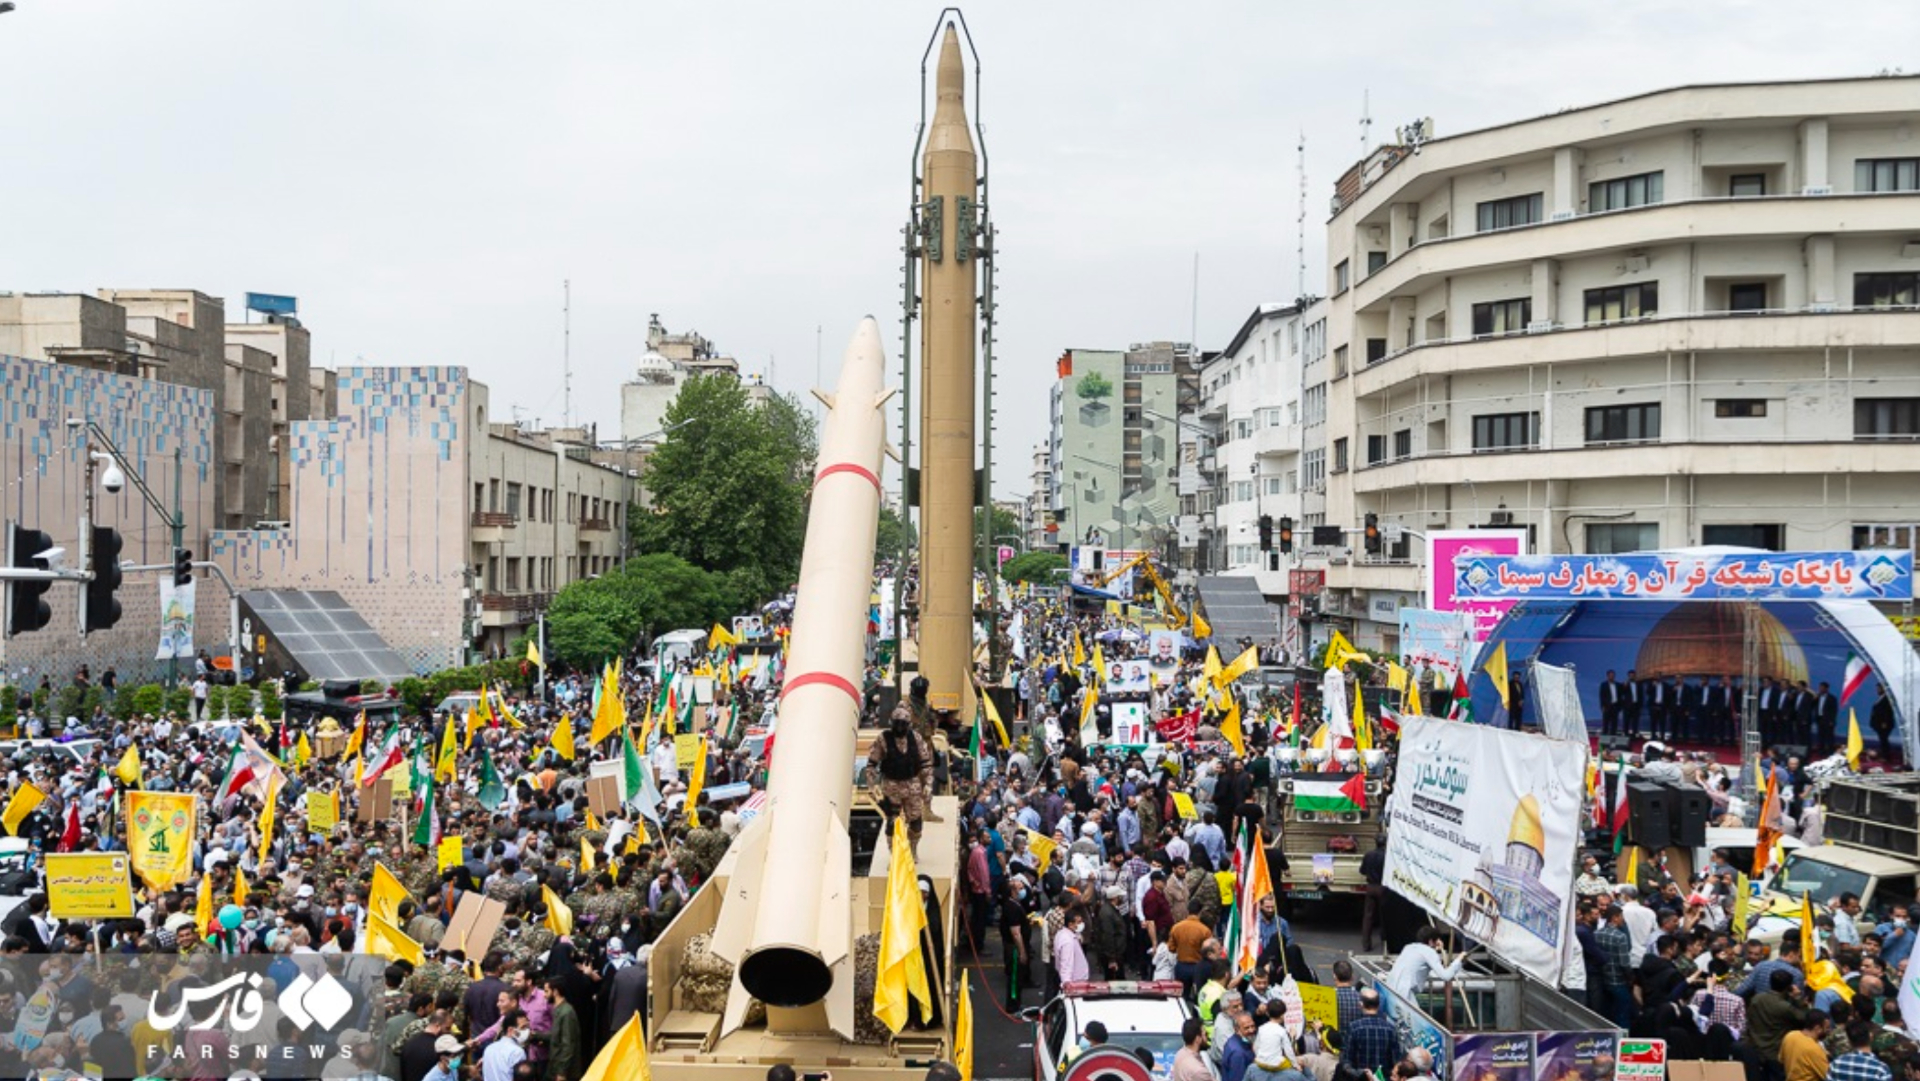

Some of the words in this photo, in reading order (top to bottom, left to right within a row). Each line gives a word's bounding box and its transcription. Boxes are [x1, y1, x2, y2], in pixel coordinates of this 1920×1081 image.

[1499, 563, 1544, 591] سیما
[1550, 562, 1618, 593] معارف
[1624, 572, 1637, 593] و
[1645, 560, 1706, 593] قرآن
[1713, 561, 1772, 591] شبکه
[1781, 561, 1852, 593] پایگاه
